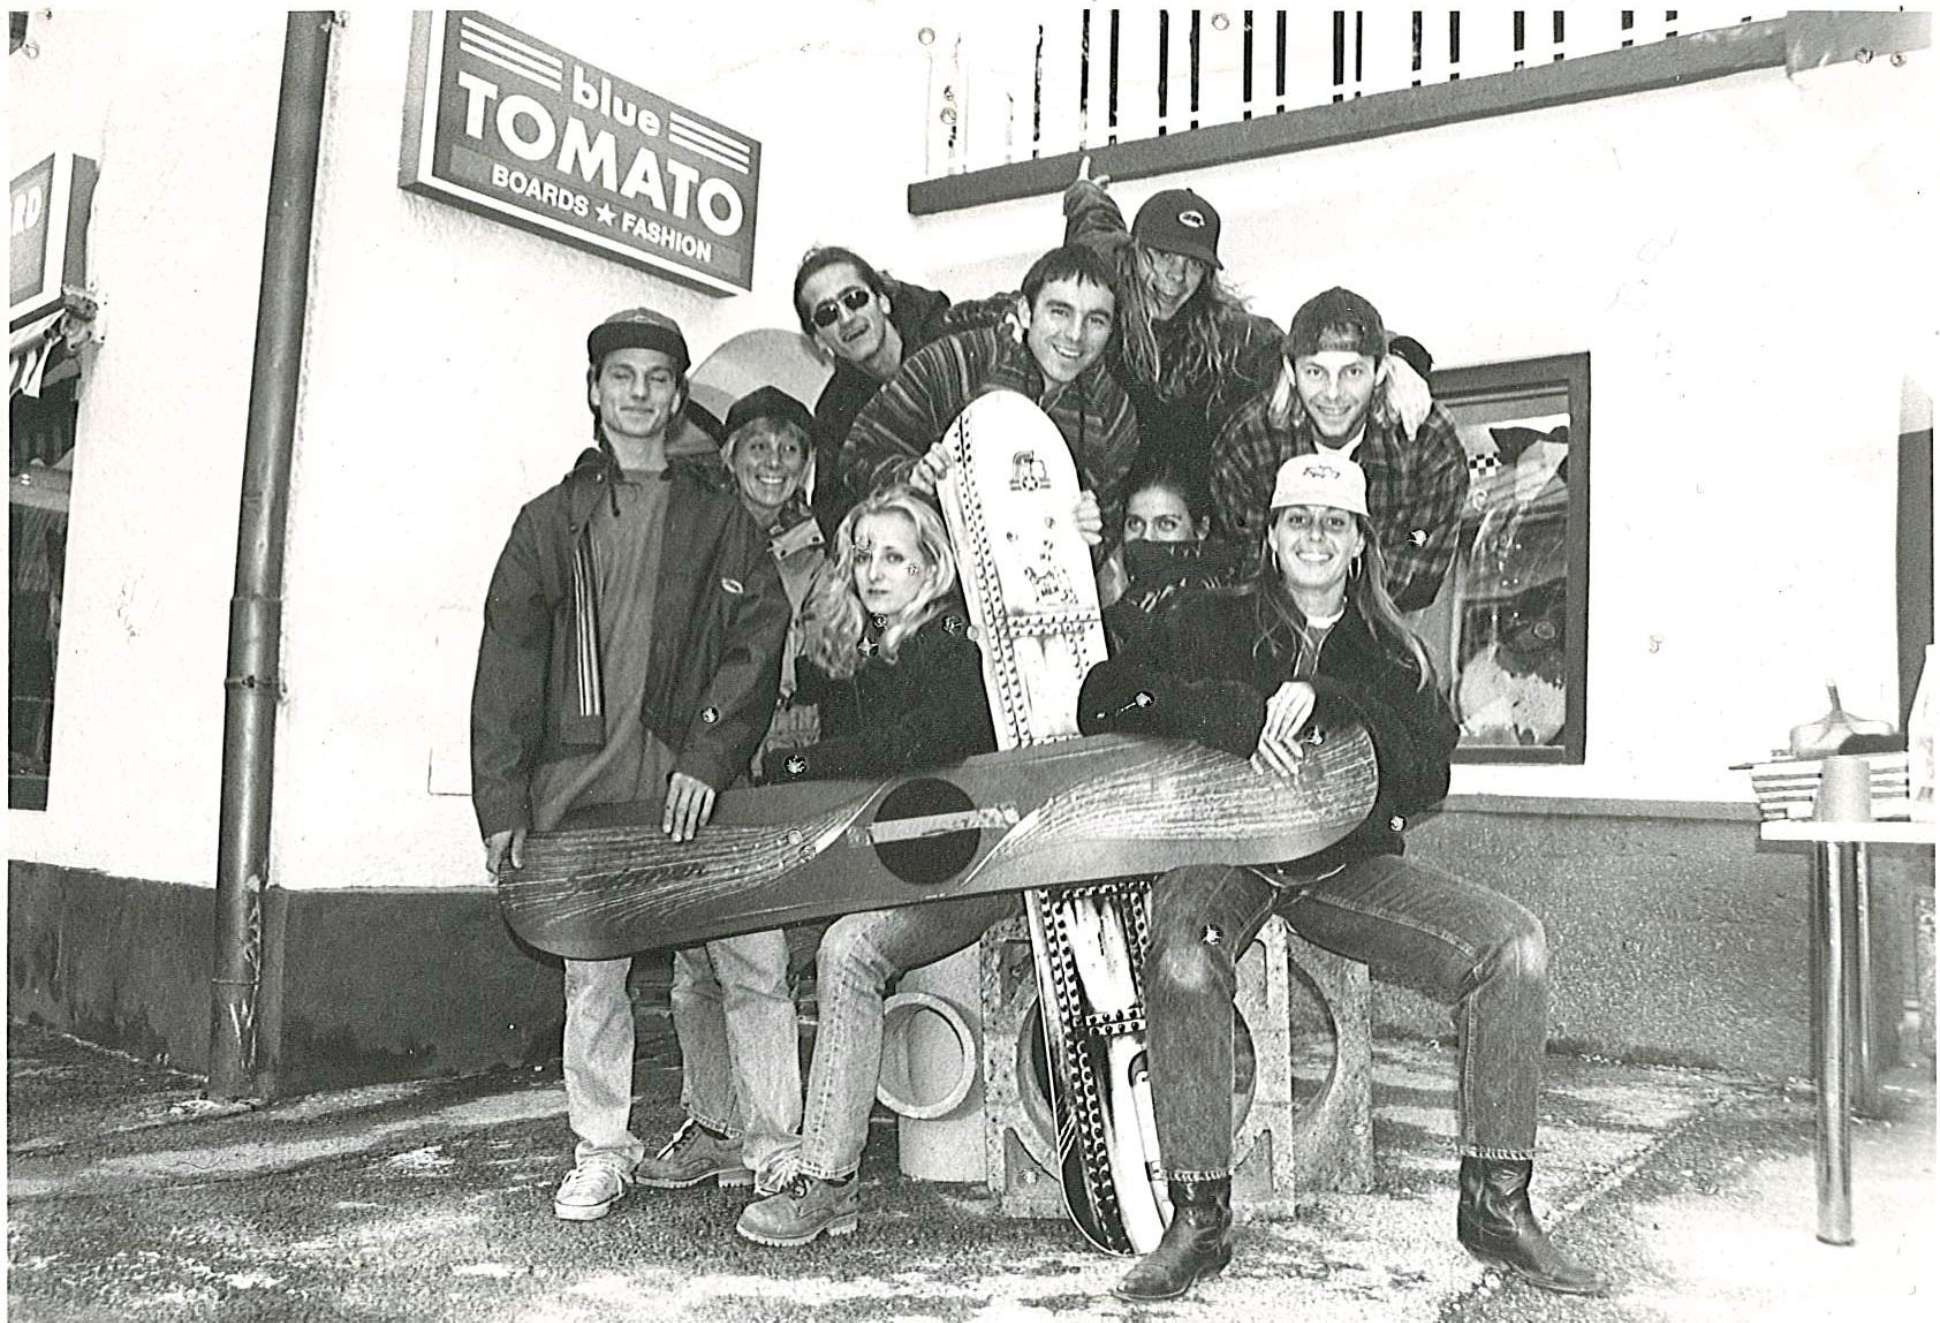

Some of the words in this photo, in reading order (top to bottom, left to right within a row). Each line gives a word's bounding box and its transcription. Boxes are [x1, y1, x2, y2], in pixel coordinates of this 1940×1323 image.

[572, 63, 661, 137] blue
[457, 70, 744, 236] TOMATO
[491, 163, 590, 217] BOARDS
[621, 211, 712, 263] FASHION
